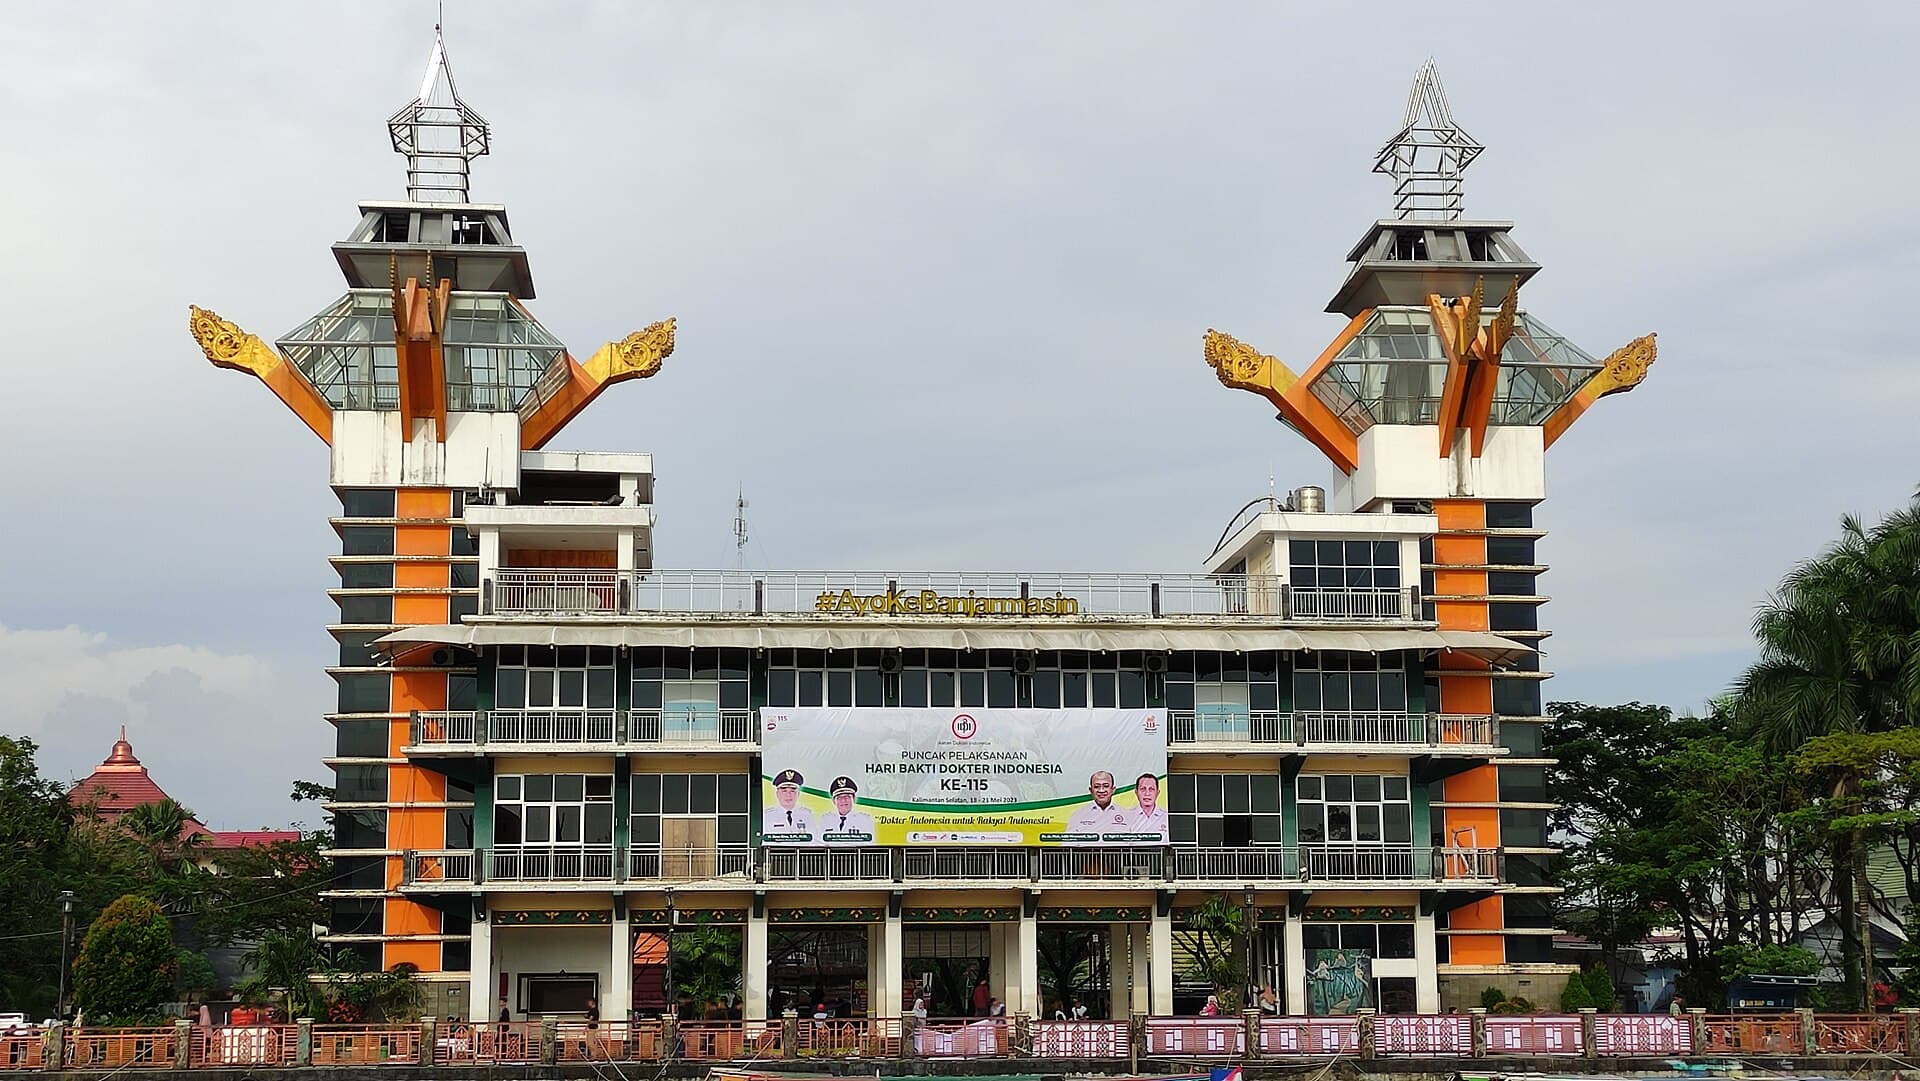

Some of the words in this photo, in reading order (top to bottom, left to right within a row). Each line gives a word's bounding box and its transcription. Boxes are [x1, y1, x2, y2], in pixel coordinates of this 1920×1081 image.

[816, 588, 1079, 617] #AyoKeBanjarmasin
[901, 751, 946, 760] PUNCAK
[949, 751, 1028, 760] PELAKSANAAN
[865, 763, 896, 774] HARI
[899, 763, 936, 774] BAKTI
[939, 763, 991, 774] DOKTER
[993, 763, 1063, 774] INDONESIA
[940, 778, 988, 791] KE-115
[909, 815, 951, 825] Indonesia
[952, 815, 975, 825] untuk
[976, 815, 1007, 827] Rakyat
